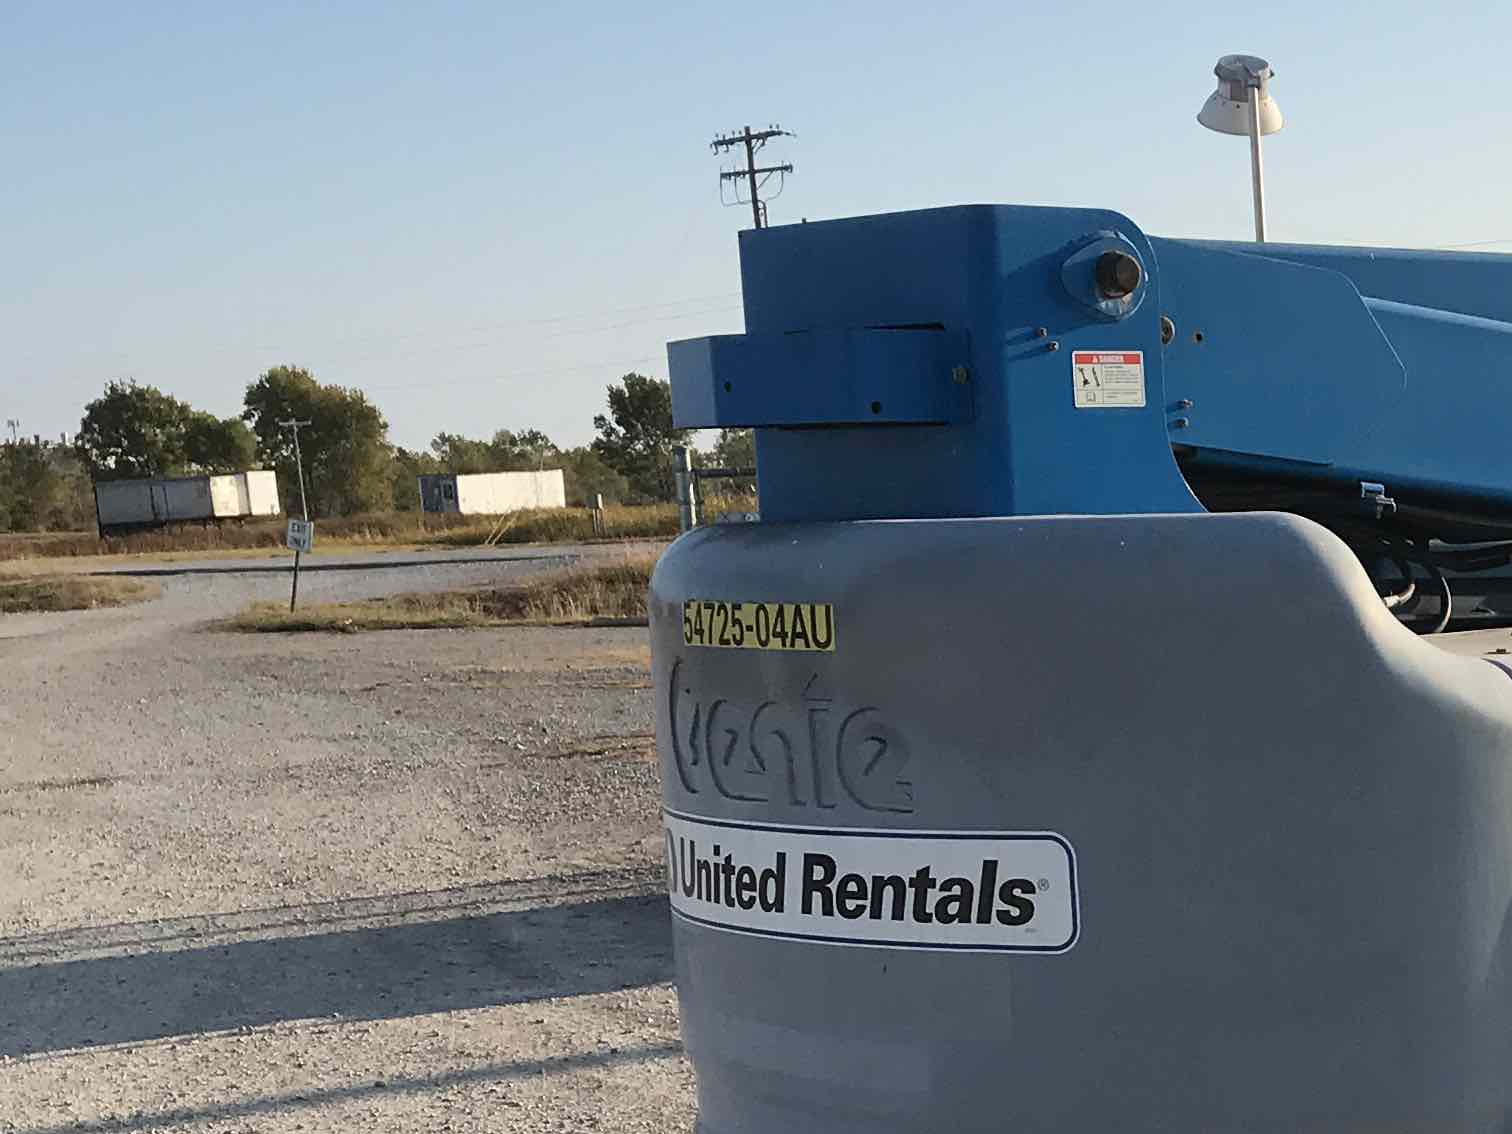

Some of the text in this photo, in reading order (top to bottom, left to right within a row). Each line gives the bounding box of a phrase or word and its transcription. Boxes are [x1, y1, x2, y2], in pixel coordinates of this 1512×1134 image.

[684, 600, 832, 649] 54725-04AU
[680, 837, 1036, 927] United Rentals
